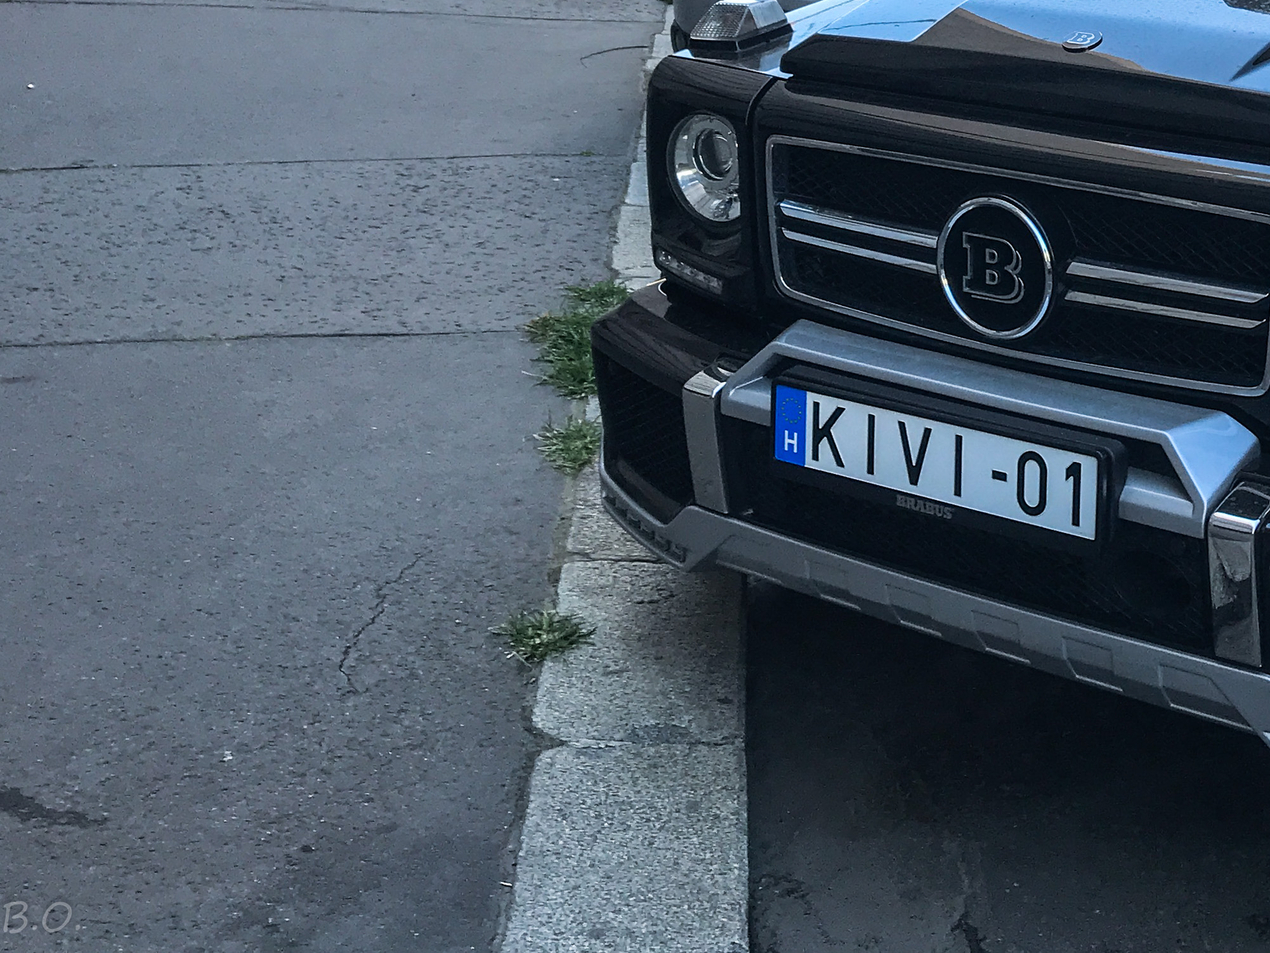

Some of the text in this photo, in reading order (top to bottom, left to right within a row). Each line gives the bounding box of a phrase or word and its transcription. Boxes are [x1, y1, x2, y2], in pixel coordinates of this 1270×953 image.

[962, 231, 1025, 305] B
[783, 429, 799, 454] H
[811, 400, 1083, 528] KIVI-01
[896, 494, 953, 520] BRABUS
